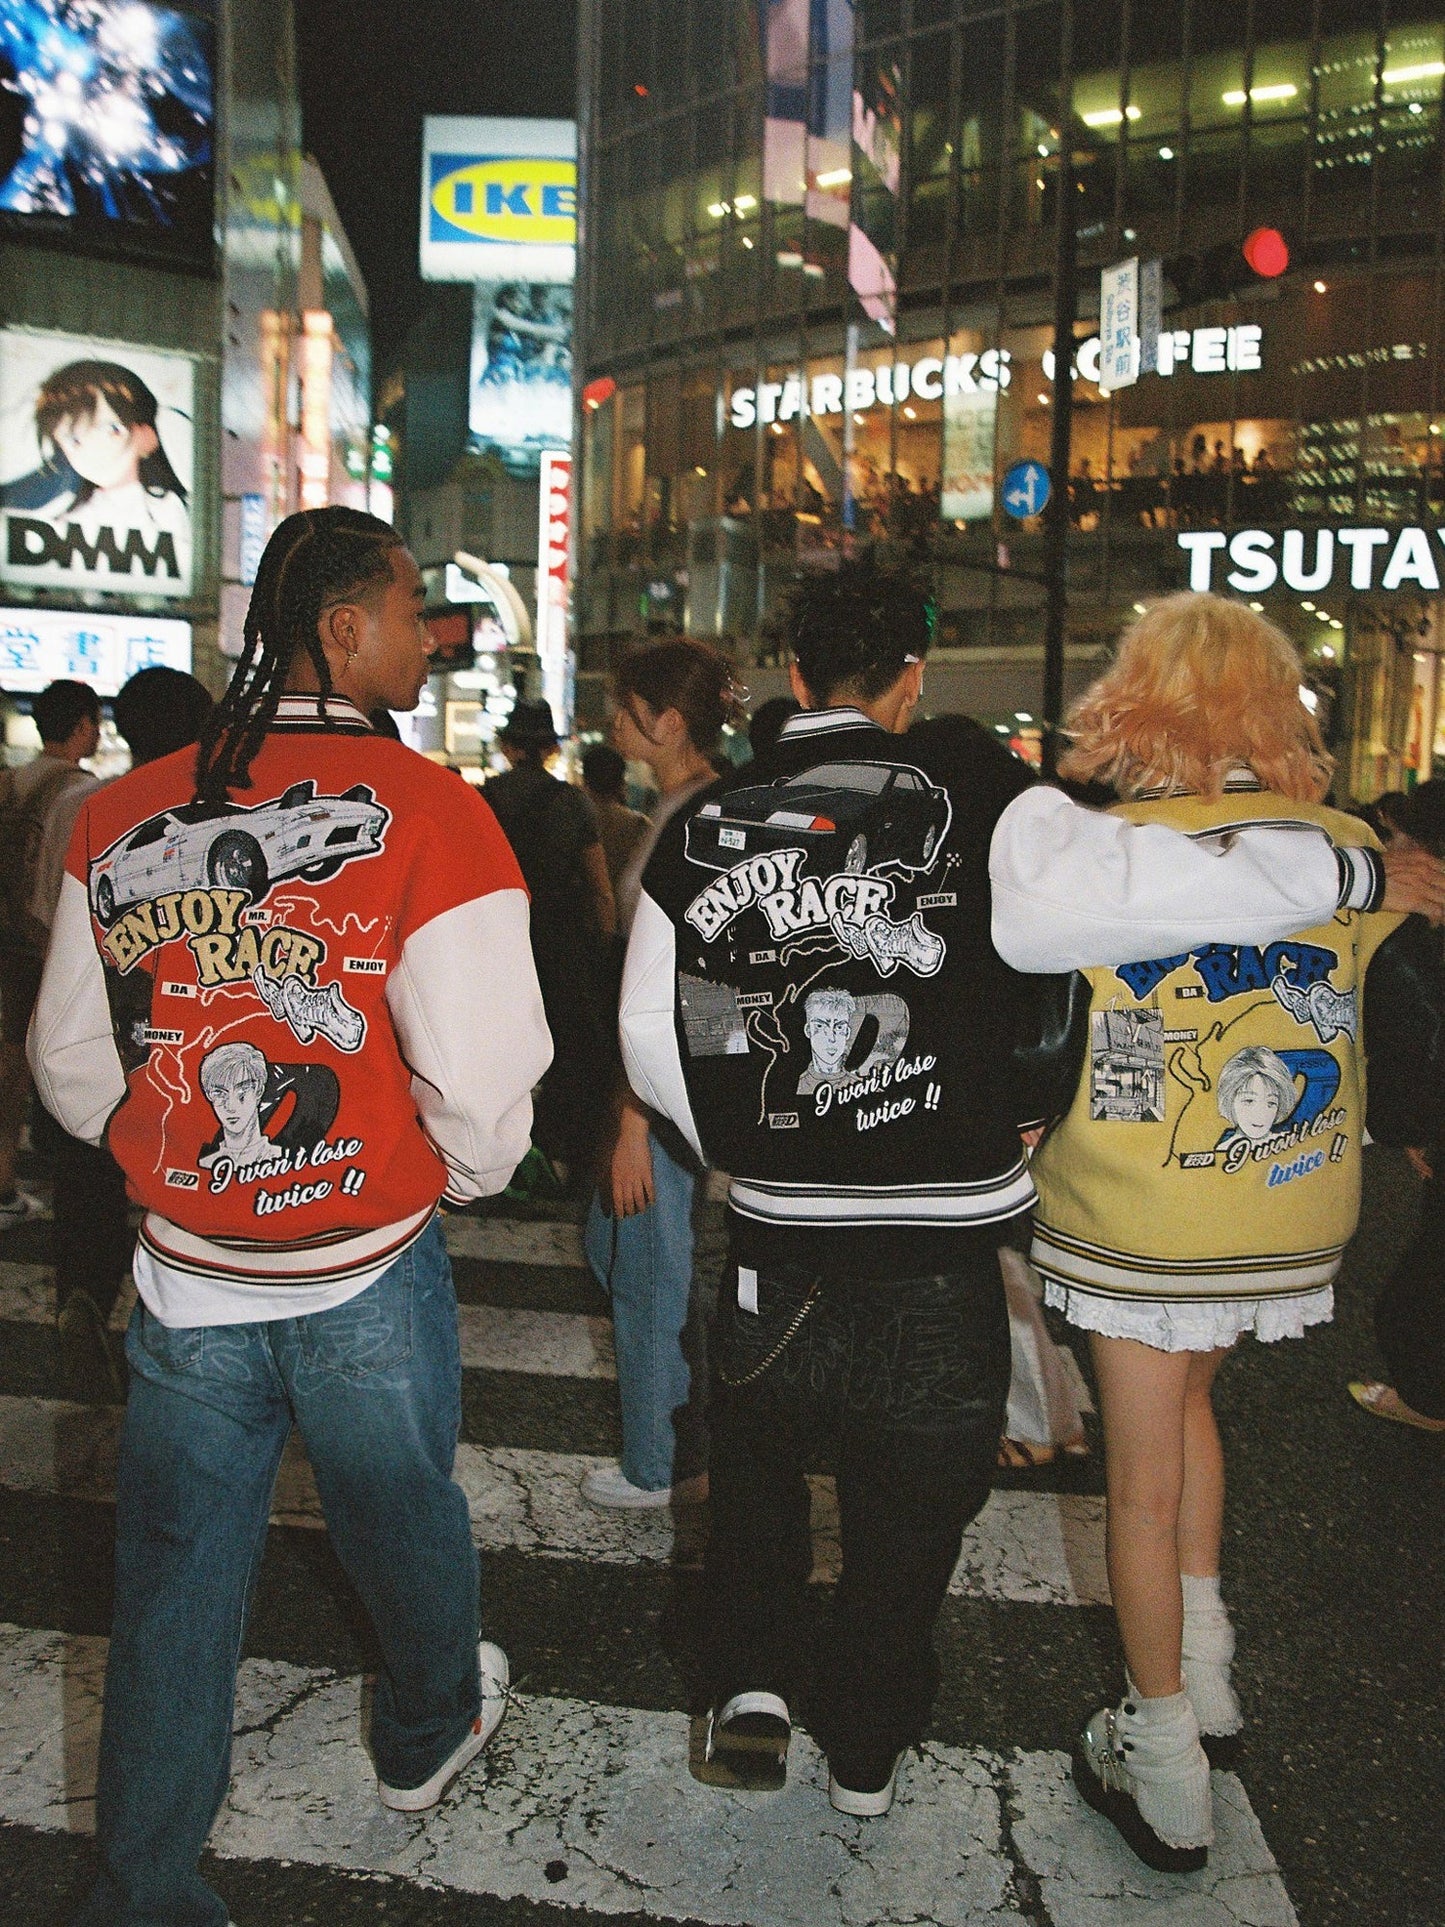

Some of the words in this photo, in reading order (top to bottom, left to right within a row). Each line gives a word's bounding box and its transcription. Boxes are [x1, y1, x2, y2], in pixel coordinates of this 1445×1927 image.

[731, 348, 1012, 428] STARBUCKS
[7, 516, 182, 580] DMM
[1178, 527, 1445, 592] TSUTA
[248, 911, 267, 921] MR.
[687, 852, 800, 939] ENJOY
[103, 889, 246, 973] ENJOY
[349, 959, 384, 971] ENJOY
[755, 952, 770, 962] DA
[170, 984, 188, 995] DA
[736, 994, 771, 1005] MONEY
[144, 1030, 182, 1041] MONEY
[837, 1065, 892, 1105] won't
[894, 1055, 937, 1083] lose
[856, 1097, 917, 1131] twice
[924, 1082, 941, 1111] !!
[1253, 1120, 1310, 1162] won't
[1310, 1110, 1348, 1137] lose
[238, 1146, 307, 1184] won't
[310, 1138, 363, 1167] lose
[1267, 1150, 1326, 1188] twice
[254, 1181, 333, 1216] twice
[341, 1168, 367, 1196] !!
